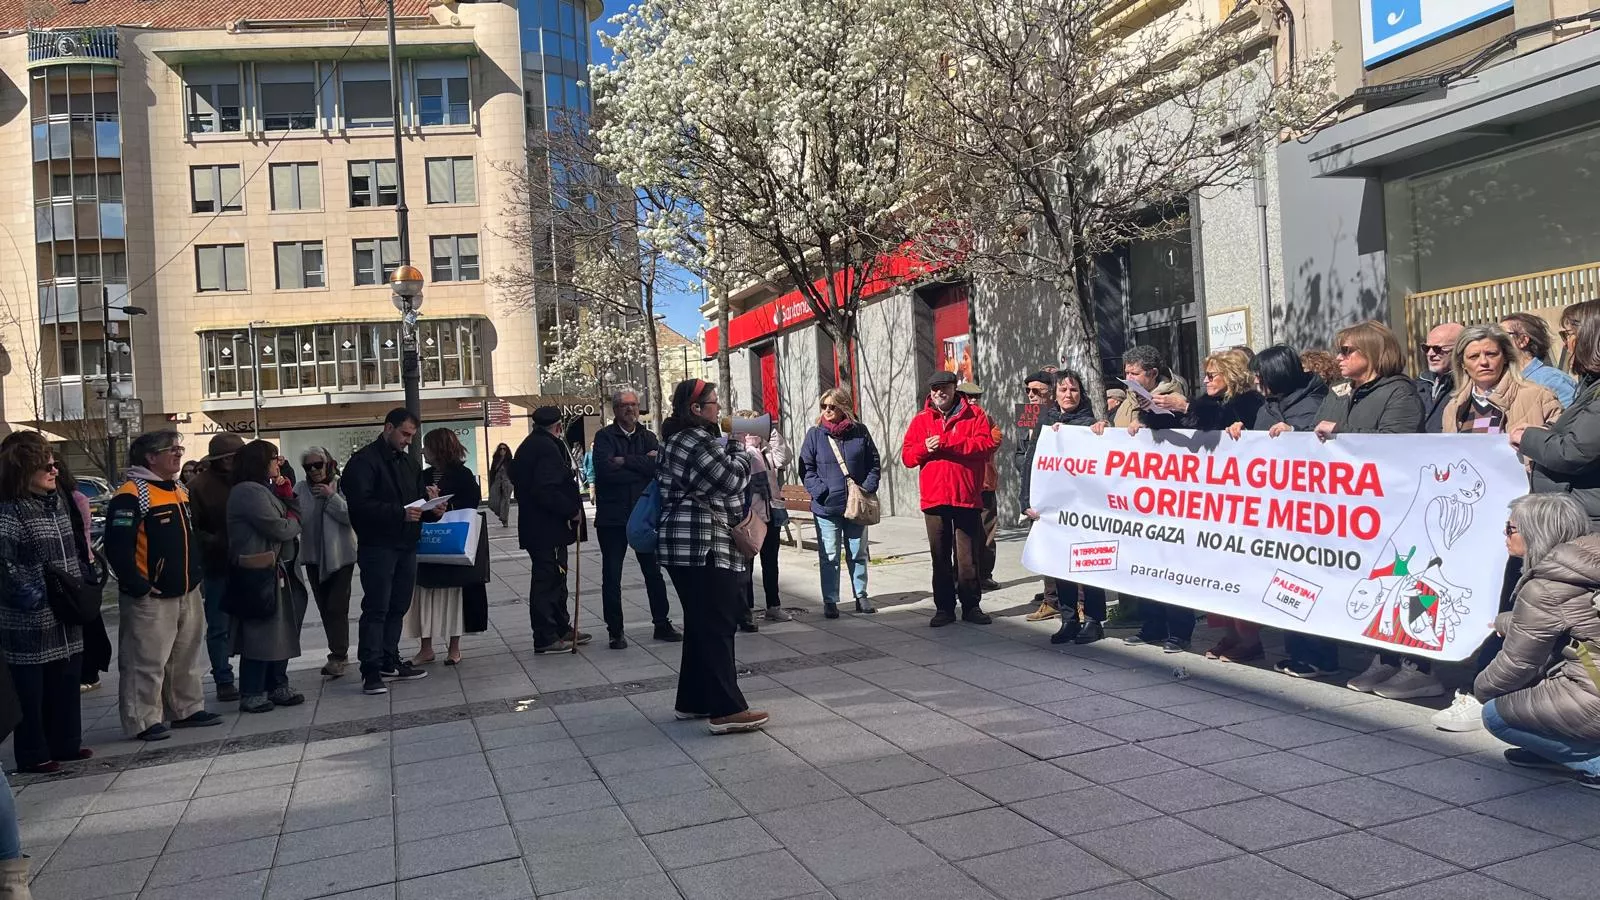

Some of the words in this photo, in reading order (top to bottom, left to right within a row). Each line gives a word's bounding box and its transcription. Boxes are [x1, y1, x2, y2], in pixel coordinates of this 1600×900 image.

[1168, 249, 1174, 265] 1
[1024, 403, 1041, 415] NO
[1037, 456, 1063, 471] HAY
[1063, 457, 1098, 476] QUE
[1104, 450, 1201, 484] PARAR
[1205, 455, 1241, 487] LA
[1246, 457, 1385, 498] GUERRA
[1107, 494, 1129, 511] EN
[1132, 486, 1262, 527] ORIENTE
[1266, 498, 1381, 541] MEDIO
[1058, 510, 1080, 527] NO
[1081, 514, 1144, 538] OLVIDAR
[1145, 524, 1185, 545] GAZA
[1196, 531, 1223, 550] NO
[1223, 535, 1246, 554] AL
[1250, 538, 1362, 571] GENOCIDIO
[1130, 563, 1241, 594] pararlaguerra.es
[1272, 576, 1316, 602] PALESTINA
[1276, 591, 1302, 609] LIBRE
